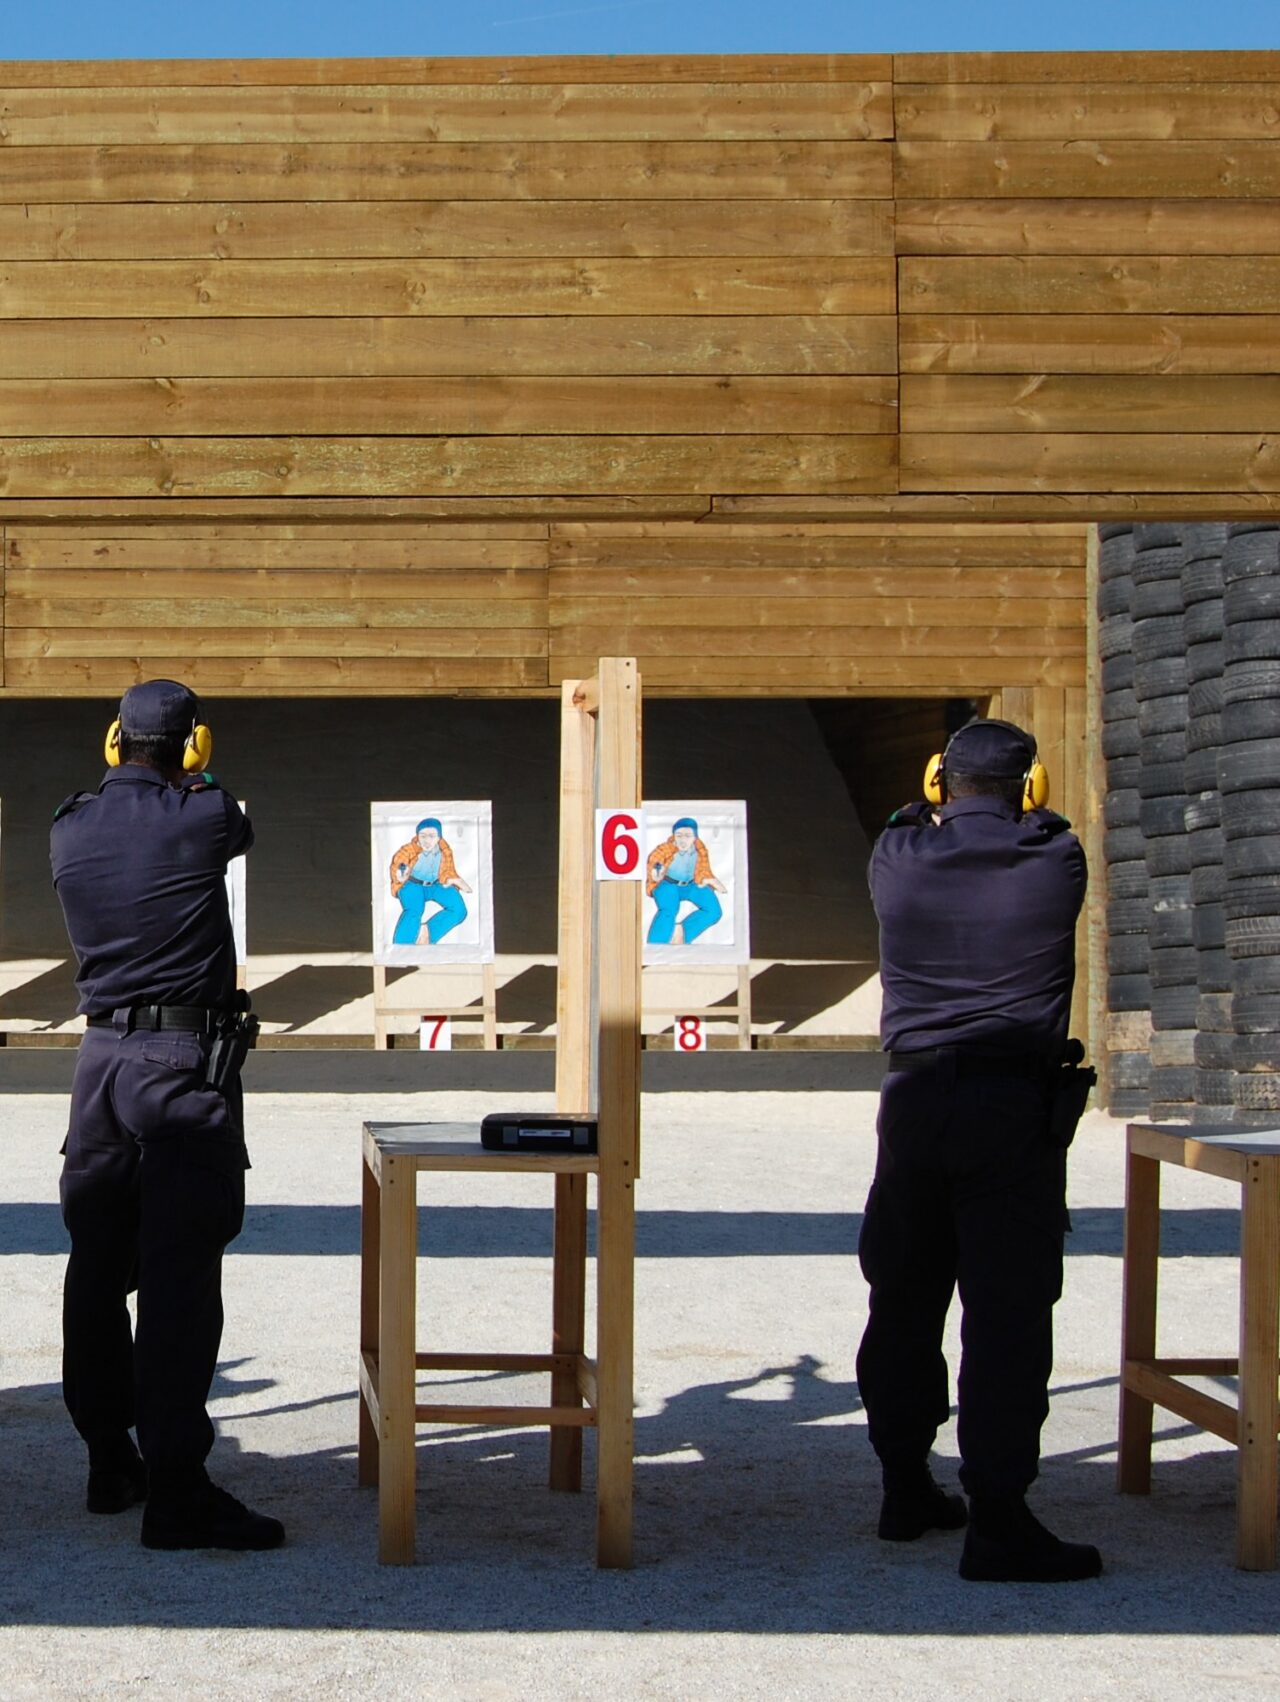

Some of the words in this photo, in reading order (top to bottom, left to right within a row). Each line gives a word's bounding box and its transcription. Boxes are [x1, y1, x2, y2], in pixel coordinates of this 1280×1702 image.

[601, 814, 639, 875] 6
[423, 1014, 447, 1050] 7
[679, 1015, 702, 1051] 8
